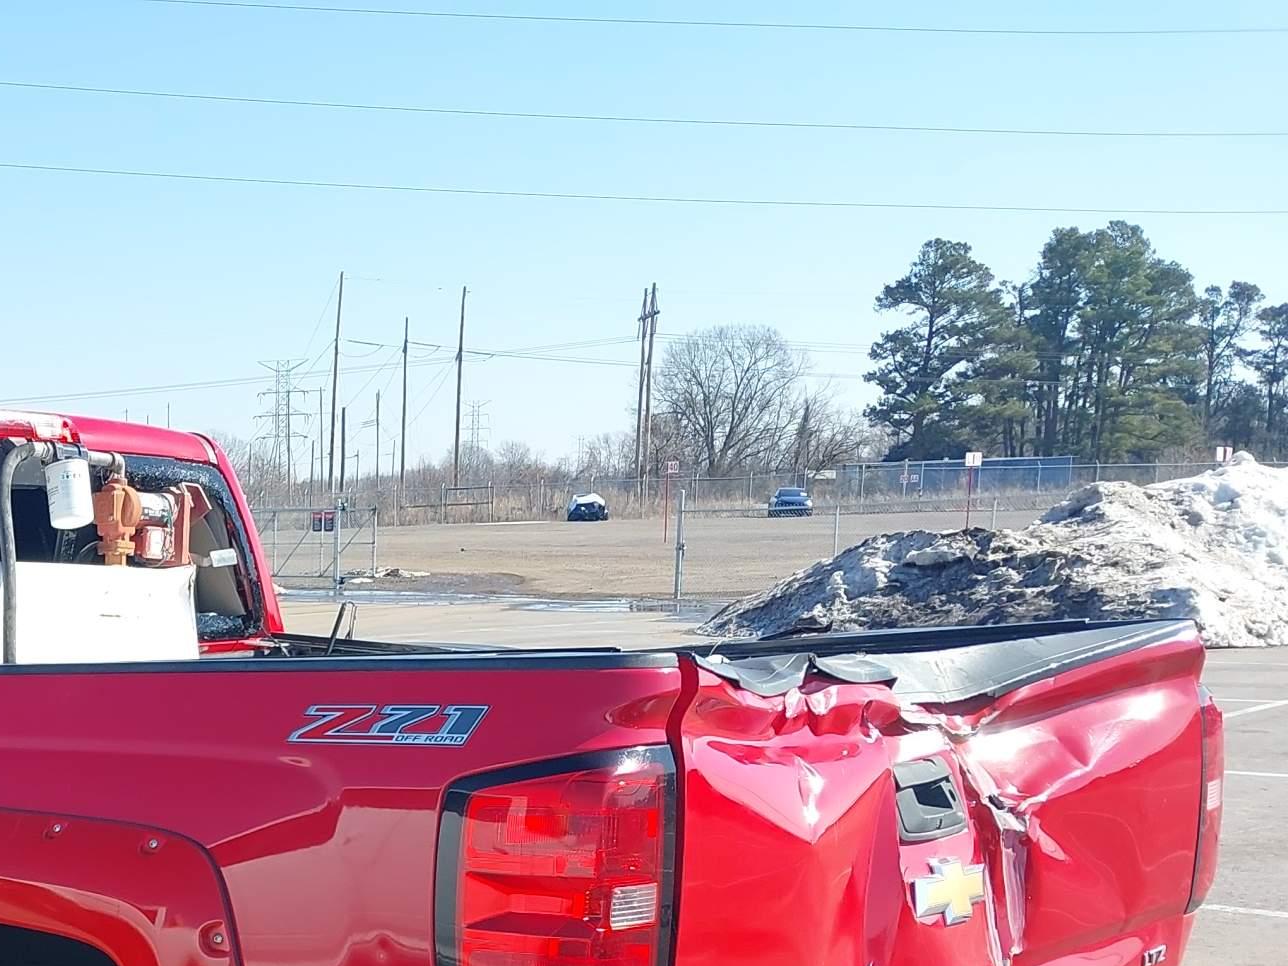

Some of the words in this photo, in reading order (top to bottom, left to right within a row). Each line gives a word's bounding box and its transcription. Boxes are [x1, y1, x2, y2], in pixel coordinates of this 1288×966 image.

[286, 704, 491, 746] Z71
[394, 735, 421, 743] OFF
[424, 735, 465, 744] ROAD
